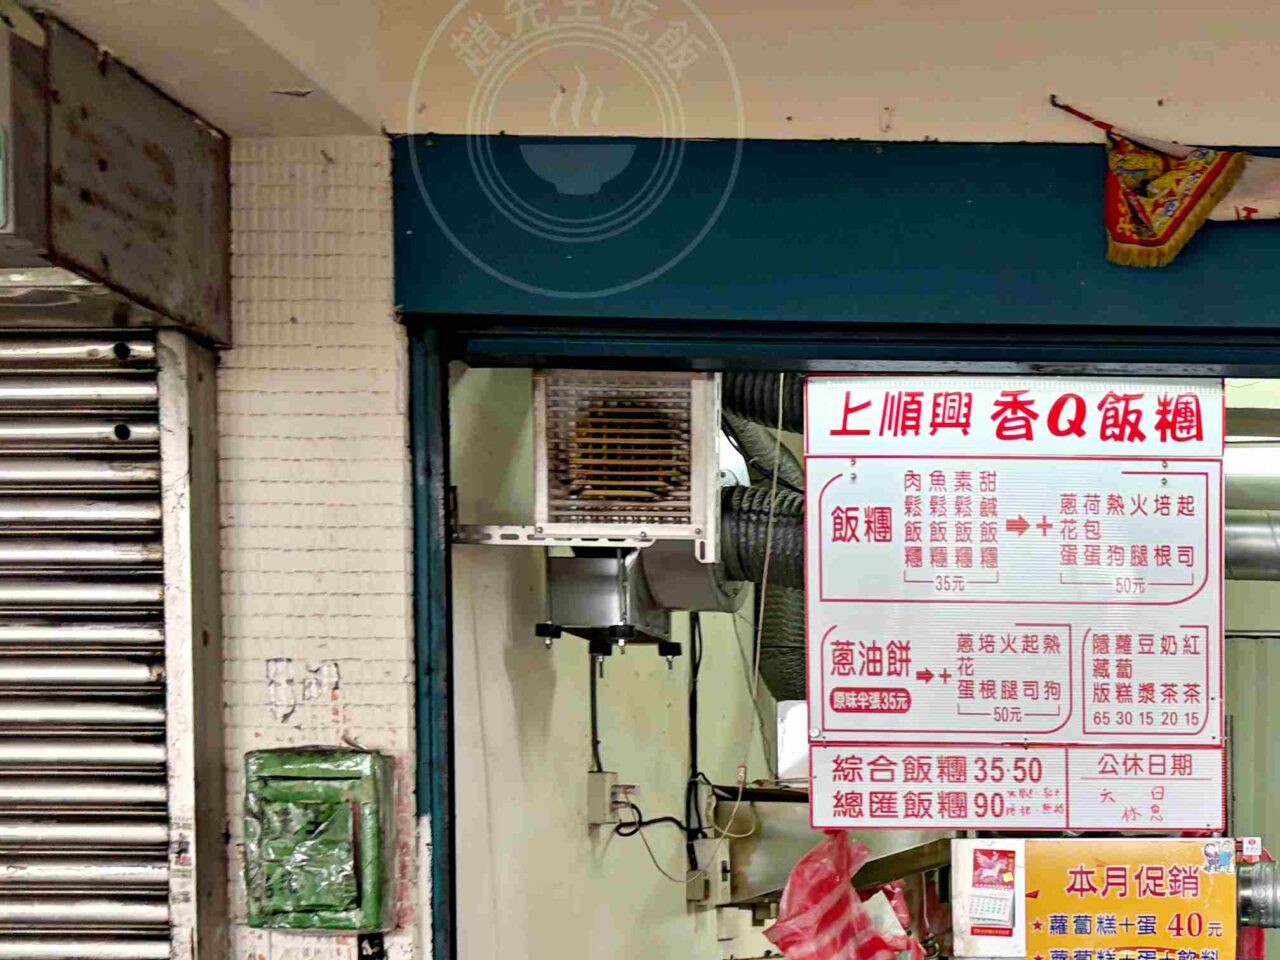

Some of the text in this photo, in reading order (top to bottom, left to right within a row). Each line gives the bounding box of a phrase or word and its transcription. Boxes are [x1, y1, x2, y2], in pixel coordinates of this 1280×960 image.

[829, 389, 1205, 442] 上順興 香Q飯糰
[831, 506, 893, 544] 飯糰
[935, 576, 965, 592] 35元
[1116, 578, 1145, 594] 50元
[830, 640, 912, 678] 蔥油餅
[993, 706, 1023, 723] 50元
[1093, 711, 1200, 726] 65 30 15 20 15
[832, 755, 967, 783] 綜合飯糰
[1098, 753, 1192, 776] 公休日期
[832, 791, 1004, 819] 總匯飯糰 90
[1065, 865, 1200, 899] 本月促銷
[1167, 912, 1203, 937] 40
[1207, 922, 1222, 937] 元
